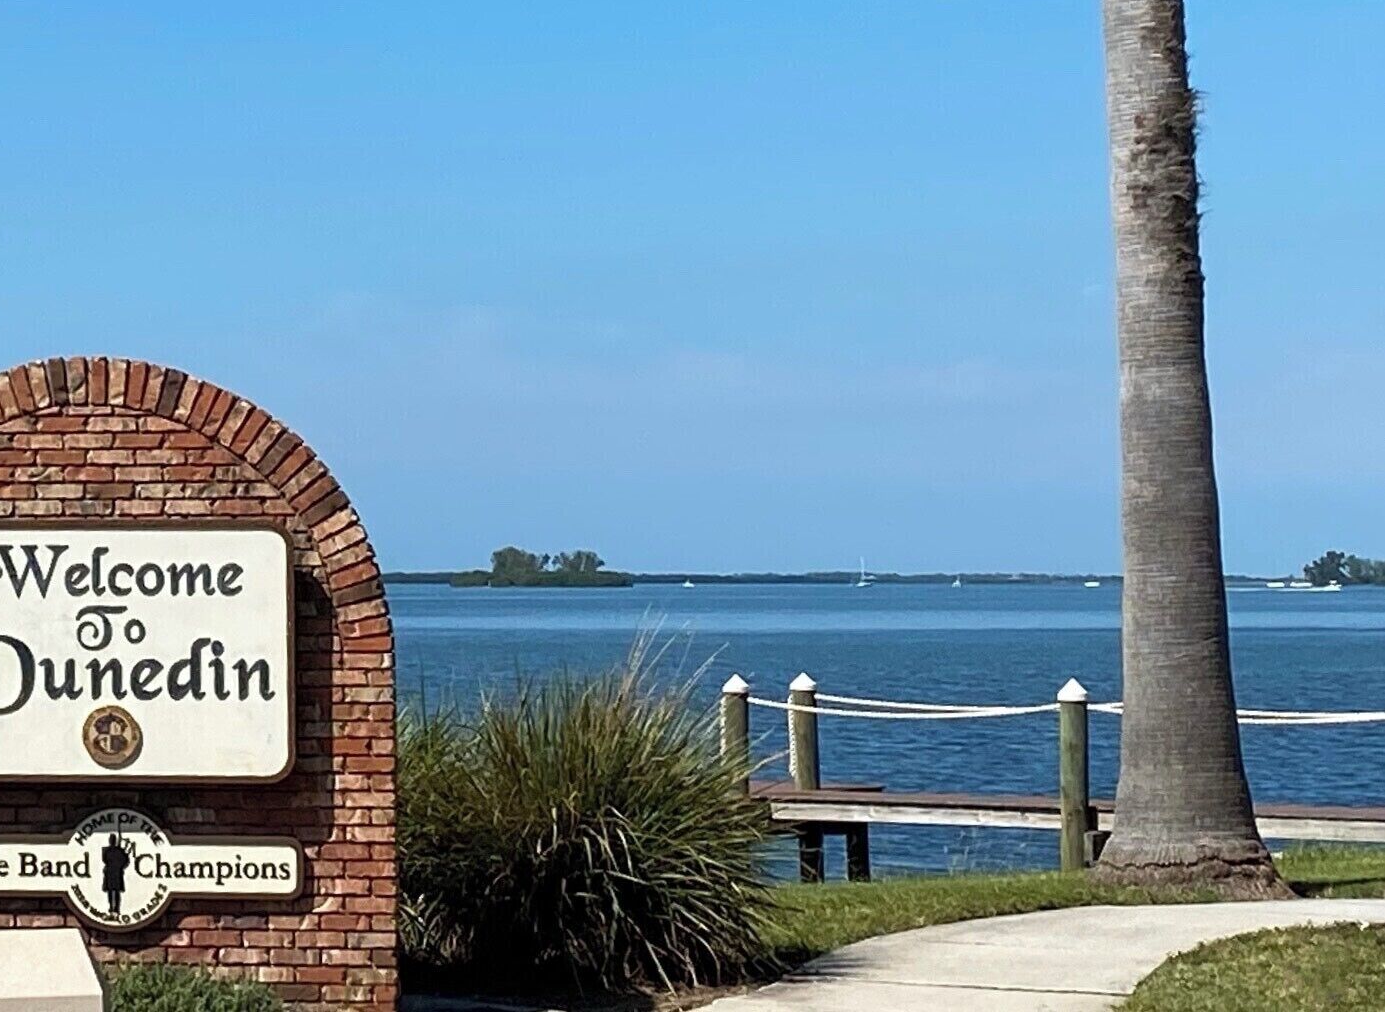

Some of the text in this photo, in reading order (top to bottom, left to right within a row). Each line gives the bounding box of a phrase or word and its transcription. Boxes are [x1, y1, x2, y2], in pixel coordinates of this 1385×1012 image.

[75, 605, 146, 651] To
[75, 812, 165, 846] HOME OF THE
[18, 852, 92, 878] Band
[134, 853, 291, 886] Champions
